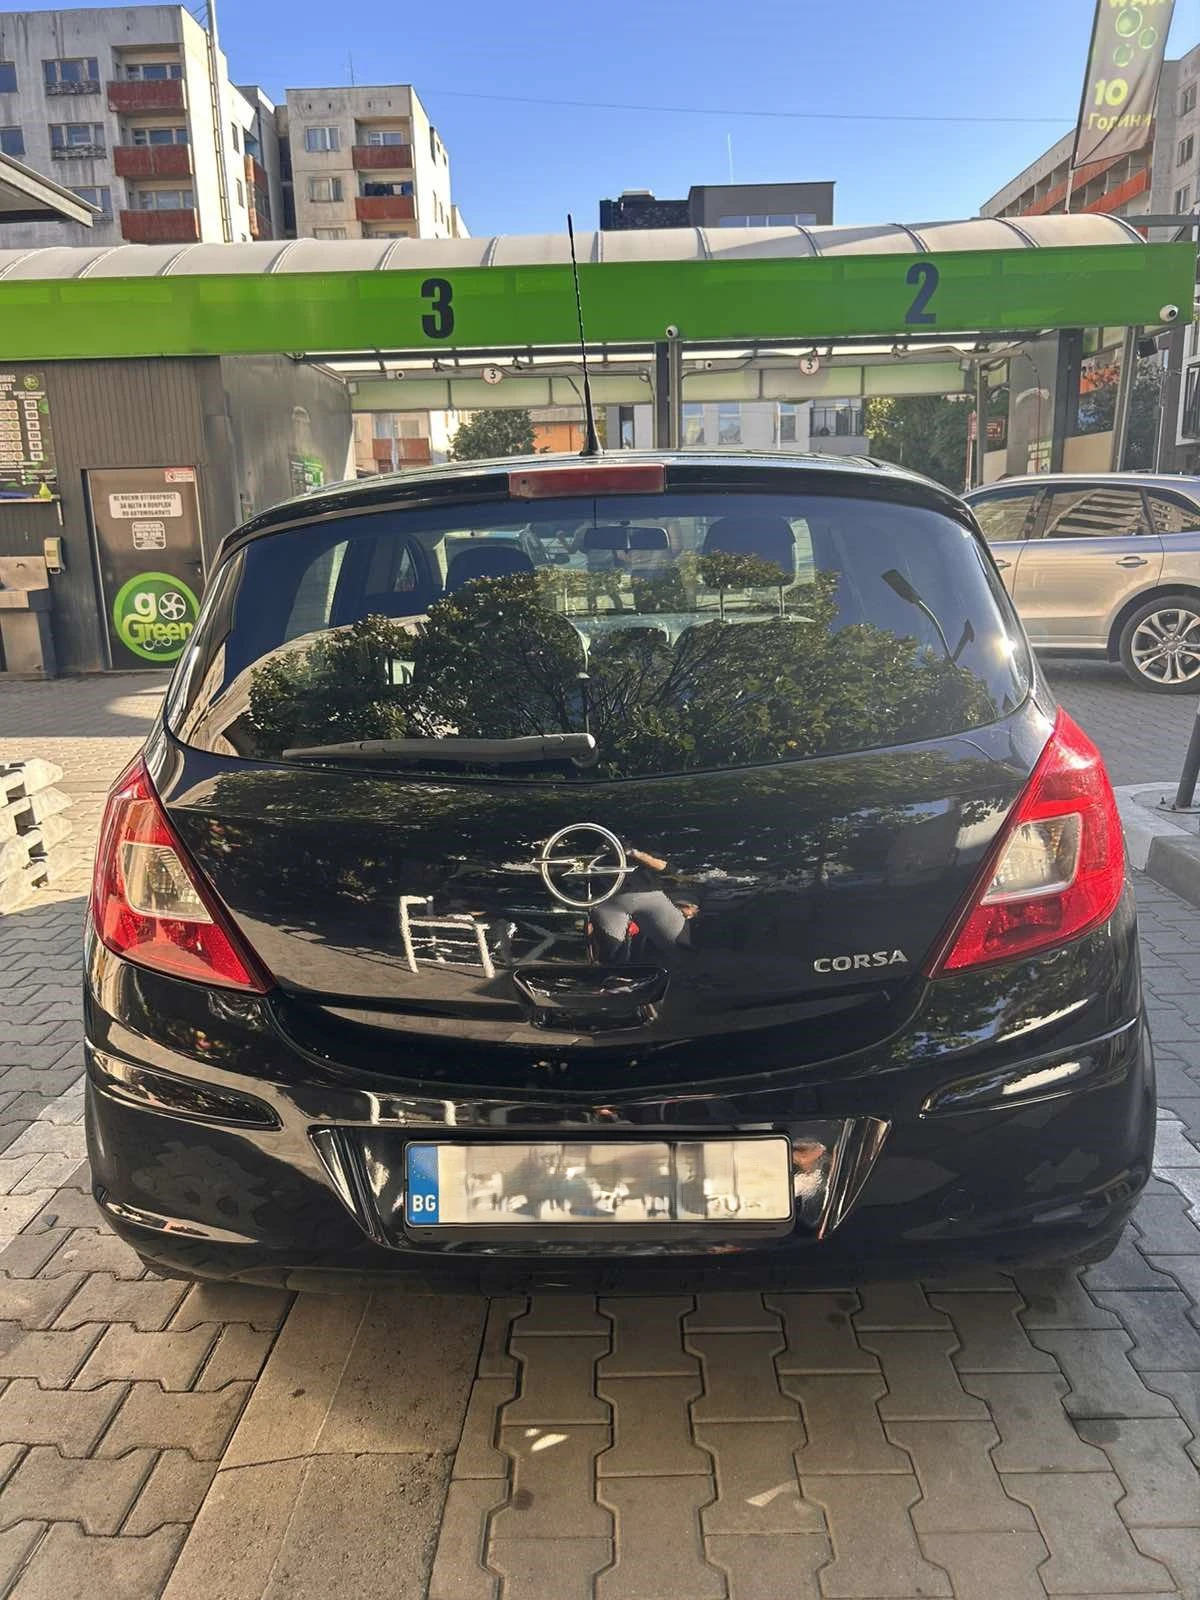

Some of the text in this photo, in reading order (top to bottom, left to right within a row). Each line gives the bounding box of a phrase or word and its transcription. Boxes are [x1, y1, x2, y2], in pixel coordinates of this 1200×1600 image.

[1094, 78, 1129, 107] 10
[905, 262, 940, 324] 2
[421, 278, 455, 339] 3
[489, 368, 497, 380] 3
[123, 613, 193, 644] Green
[813, 949, 909, 973] CORSA
[412, 1194, 436, 1213] BG
